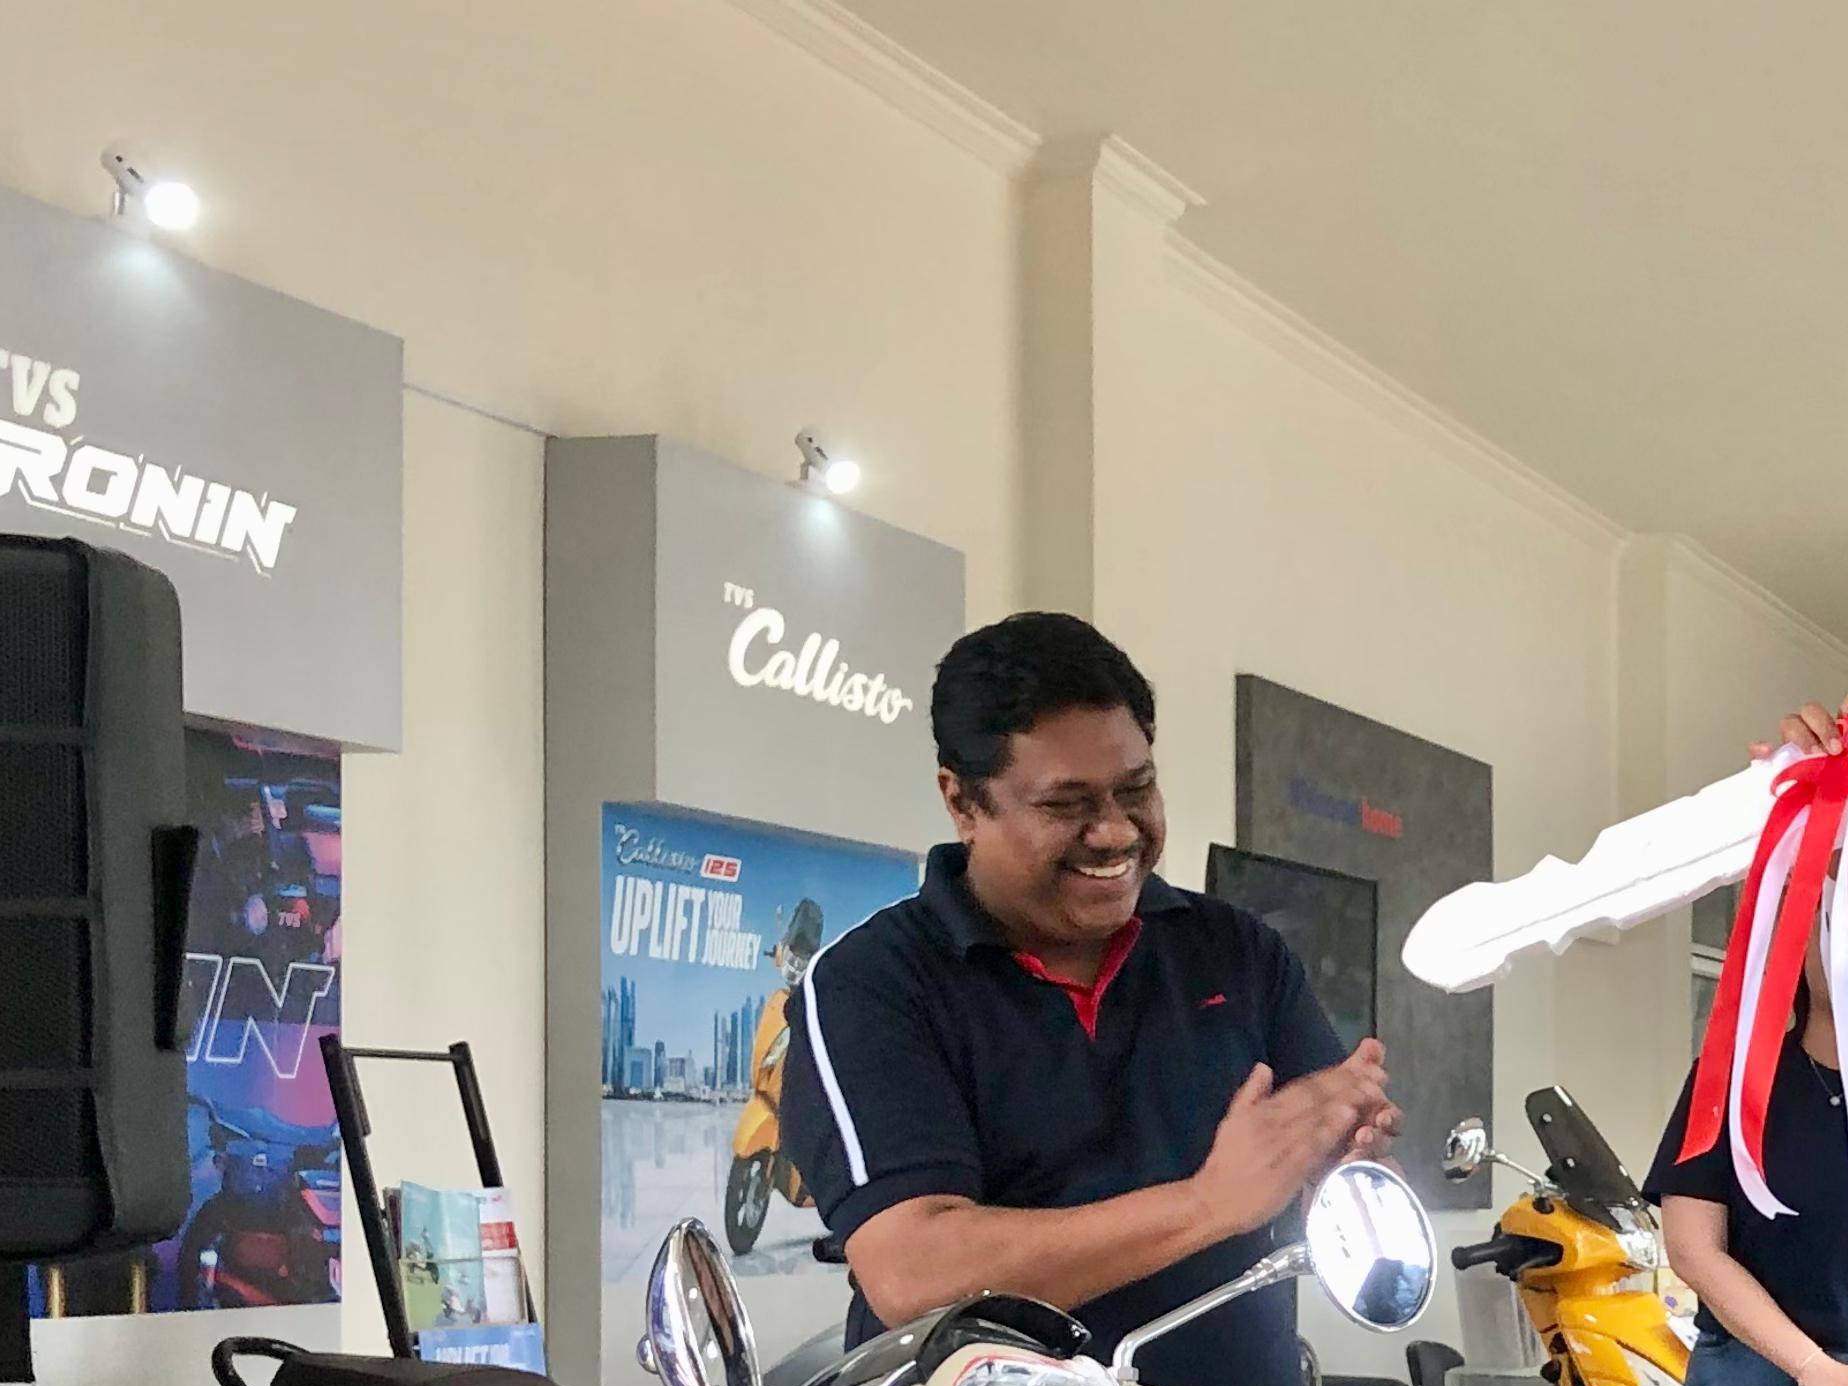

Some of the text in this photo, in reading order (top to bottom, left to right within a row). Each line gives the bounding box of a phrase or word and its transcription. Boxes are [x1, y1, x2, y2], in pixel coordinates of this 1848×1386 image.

[0, 419, 298, 570] RONIN
[723, 581, 755, 609] TVS
[728, 606, 913, 724] Callisto
[703, 857, 738, 878] 125
[610, 874, 706, 963] UPLIFT
[707, 889, 743, 930] YOUR
[701, 929, 762, 971] JOURNEY
